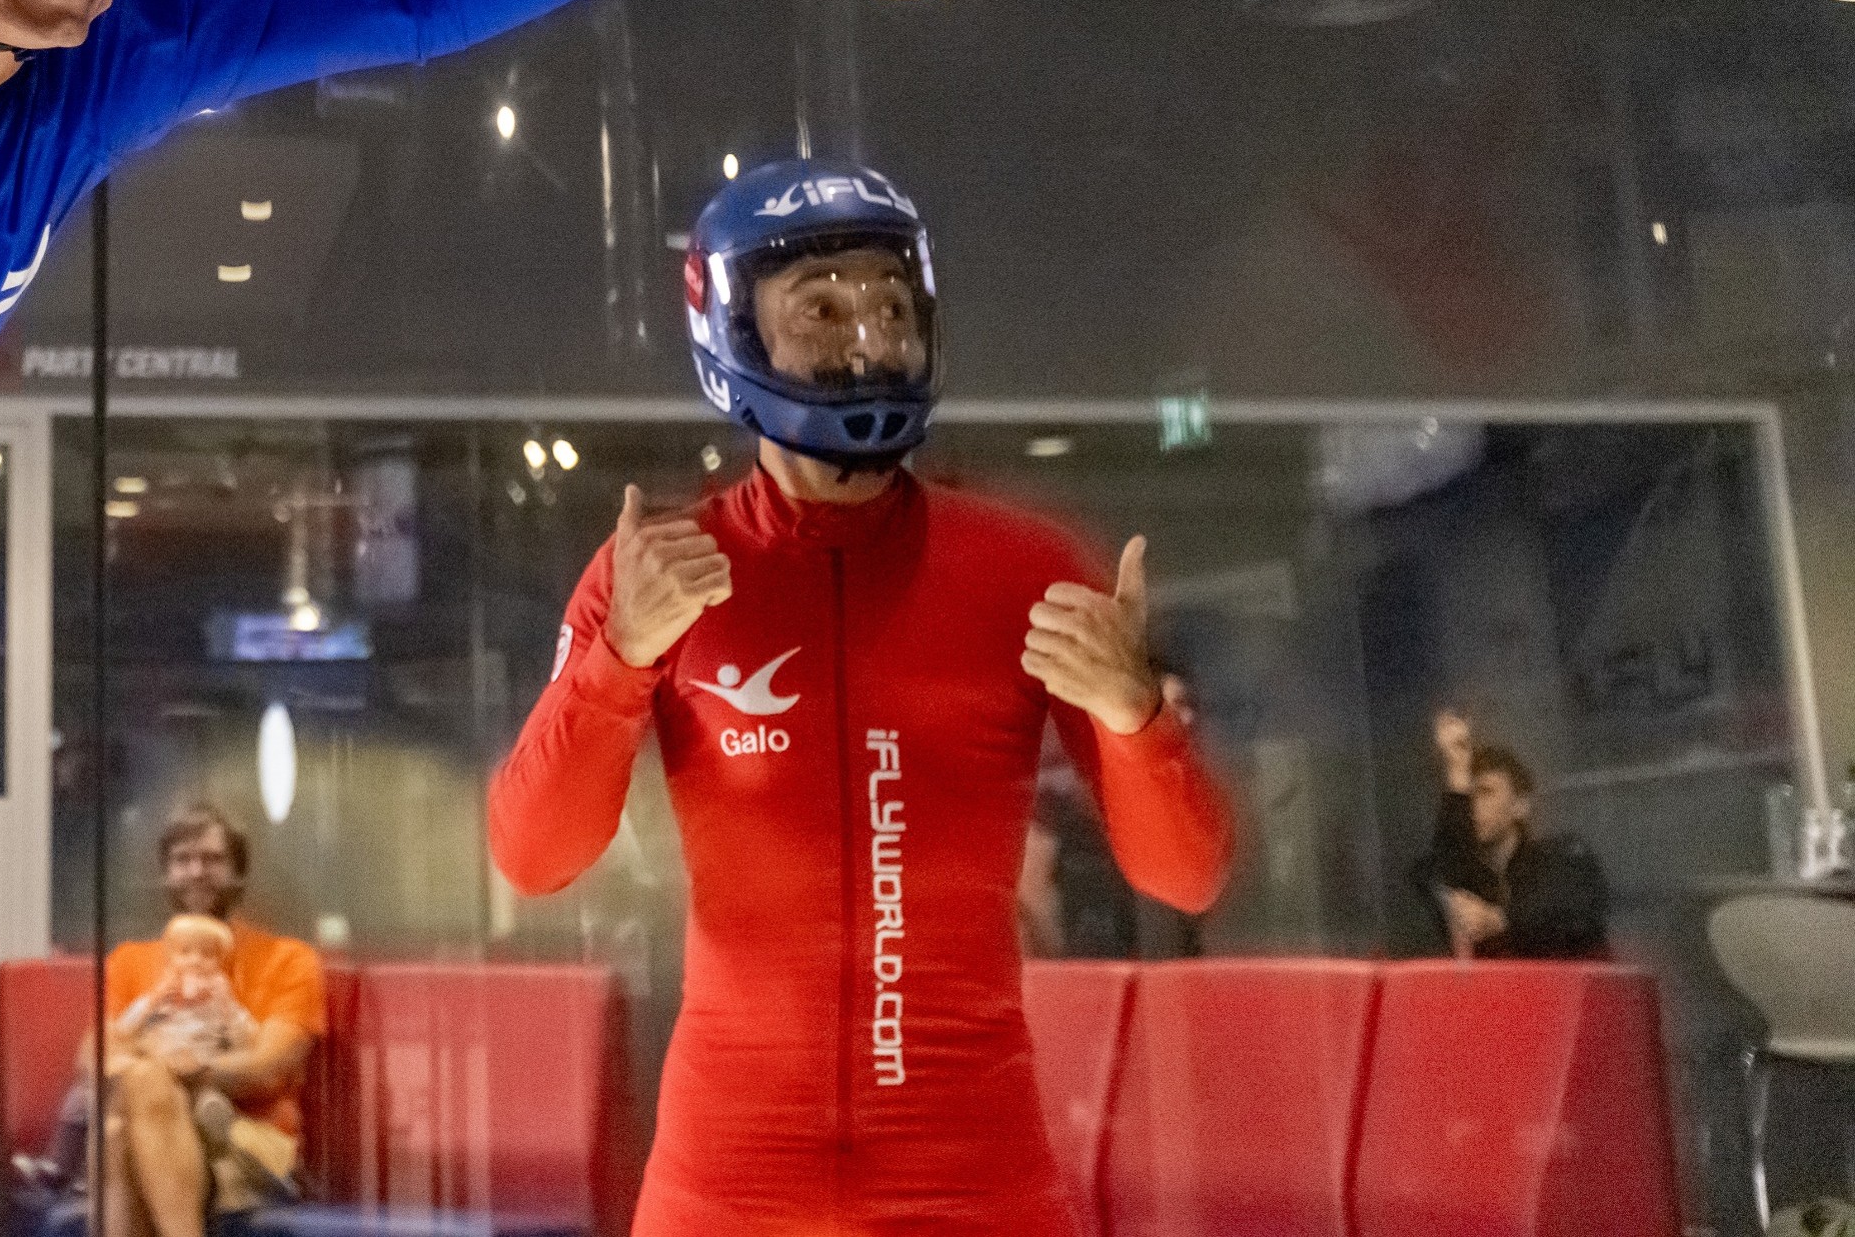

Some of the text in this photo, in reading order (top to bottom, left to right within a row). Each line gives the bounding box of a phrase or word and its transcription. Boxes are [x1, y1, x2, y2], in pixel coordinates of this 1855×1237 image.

[22, 348, 114, 378] PART
[719, 724, 791, 758] Galo
[866, 727, 905, 1087] iFLYWORLD.COM
